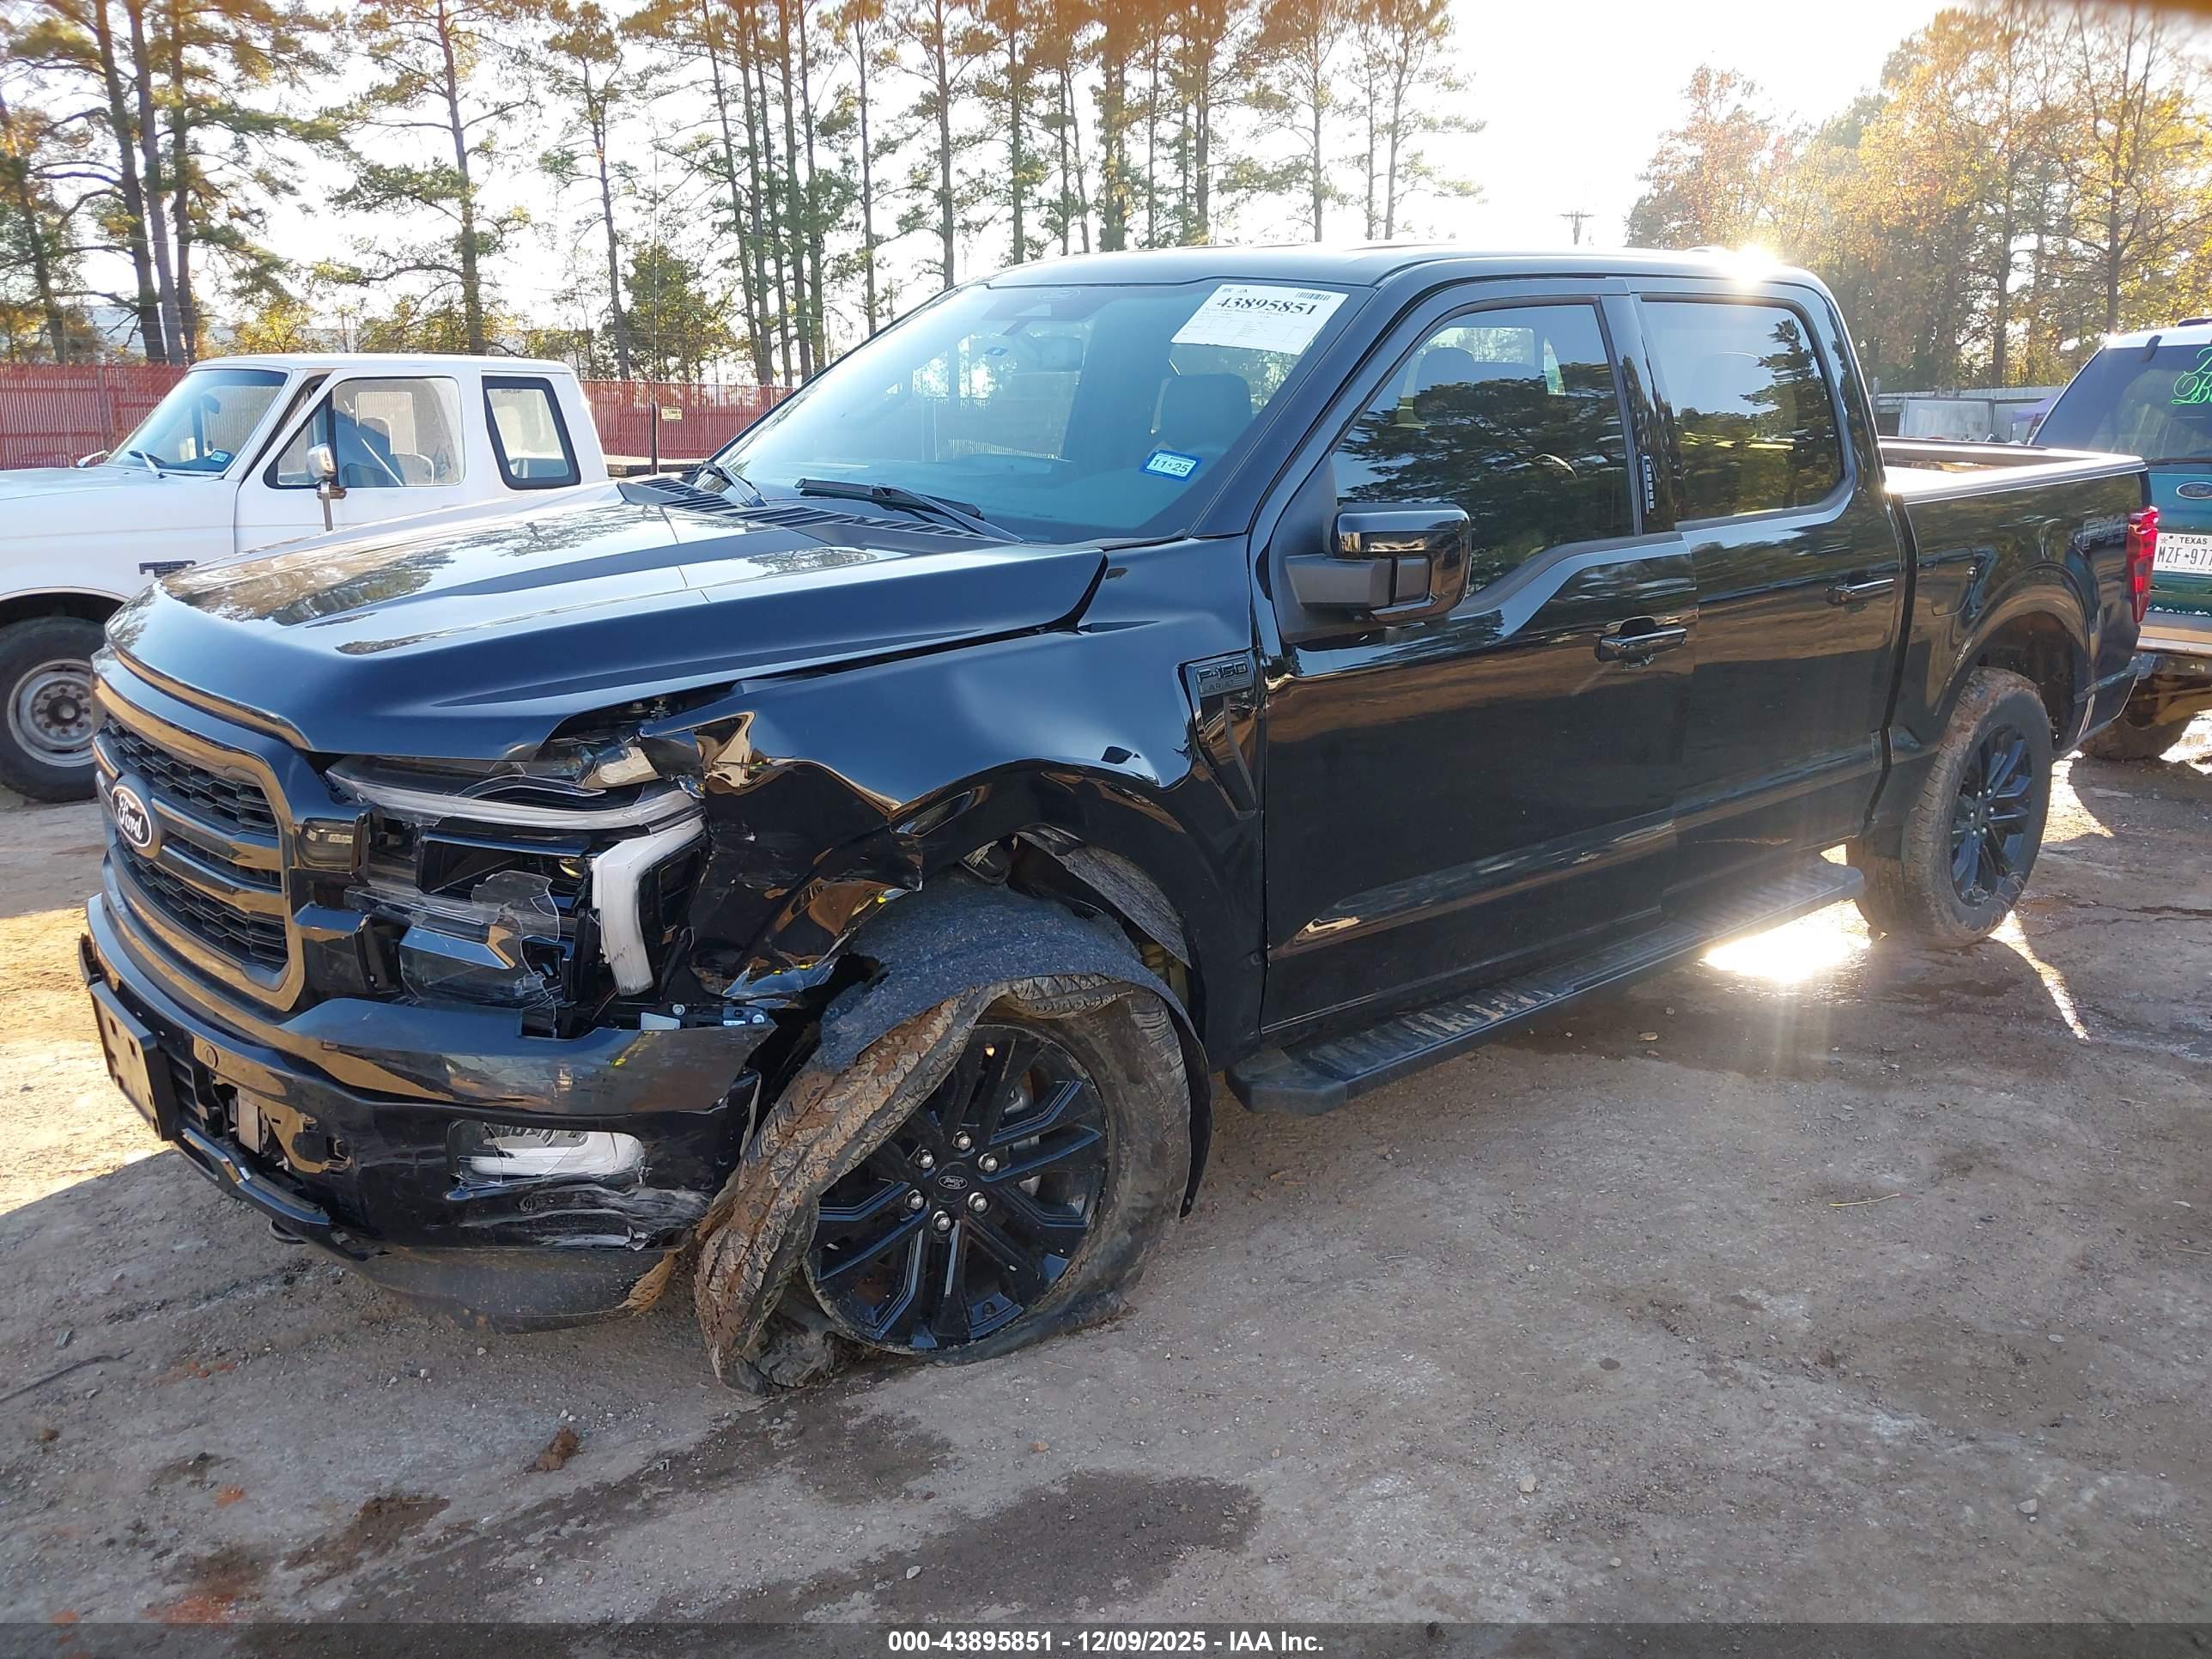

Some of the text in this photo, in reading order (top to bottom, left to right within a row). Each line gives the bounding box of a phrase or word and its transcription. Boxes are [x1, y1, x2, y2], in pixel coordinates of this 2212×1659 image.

[1217, 297, 1319, 315] 43895851
[2179, 537, 2208, 545] TEXAS
[1197, 661, 1248, 684] F-150
[116, 791, 145, 842] Ford
